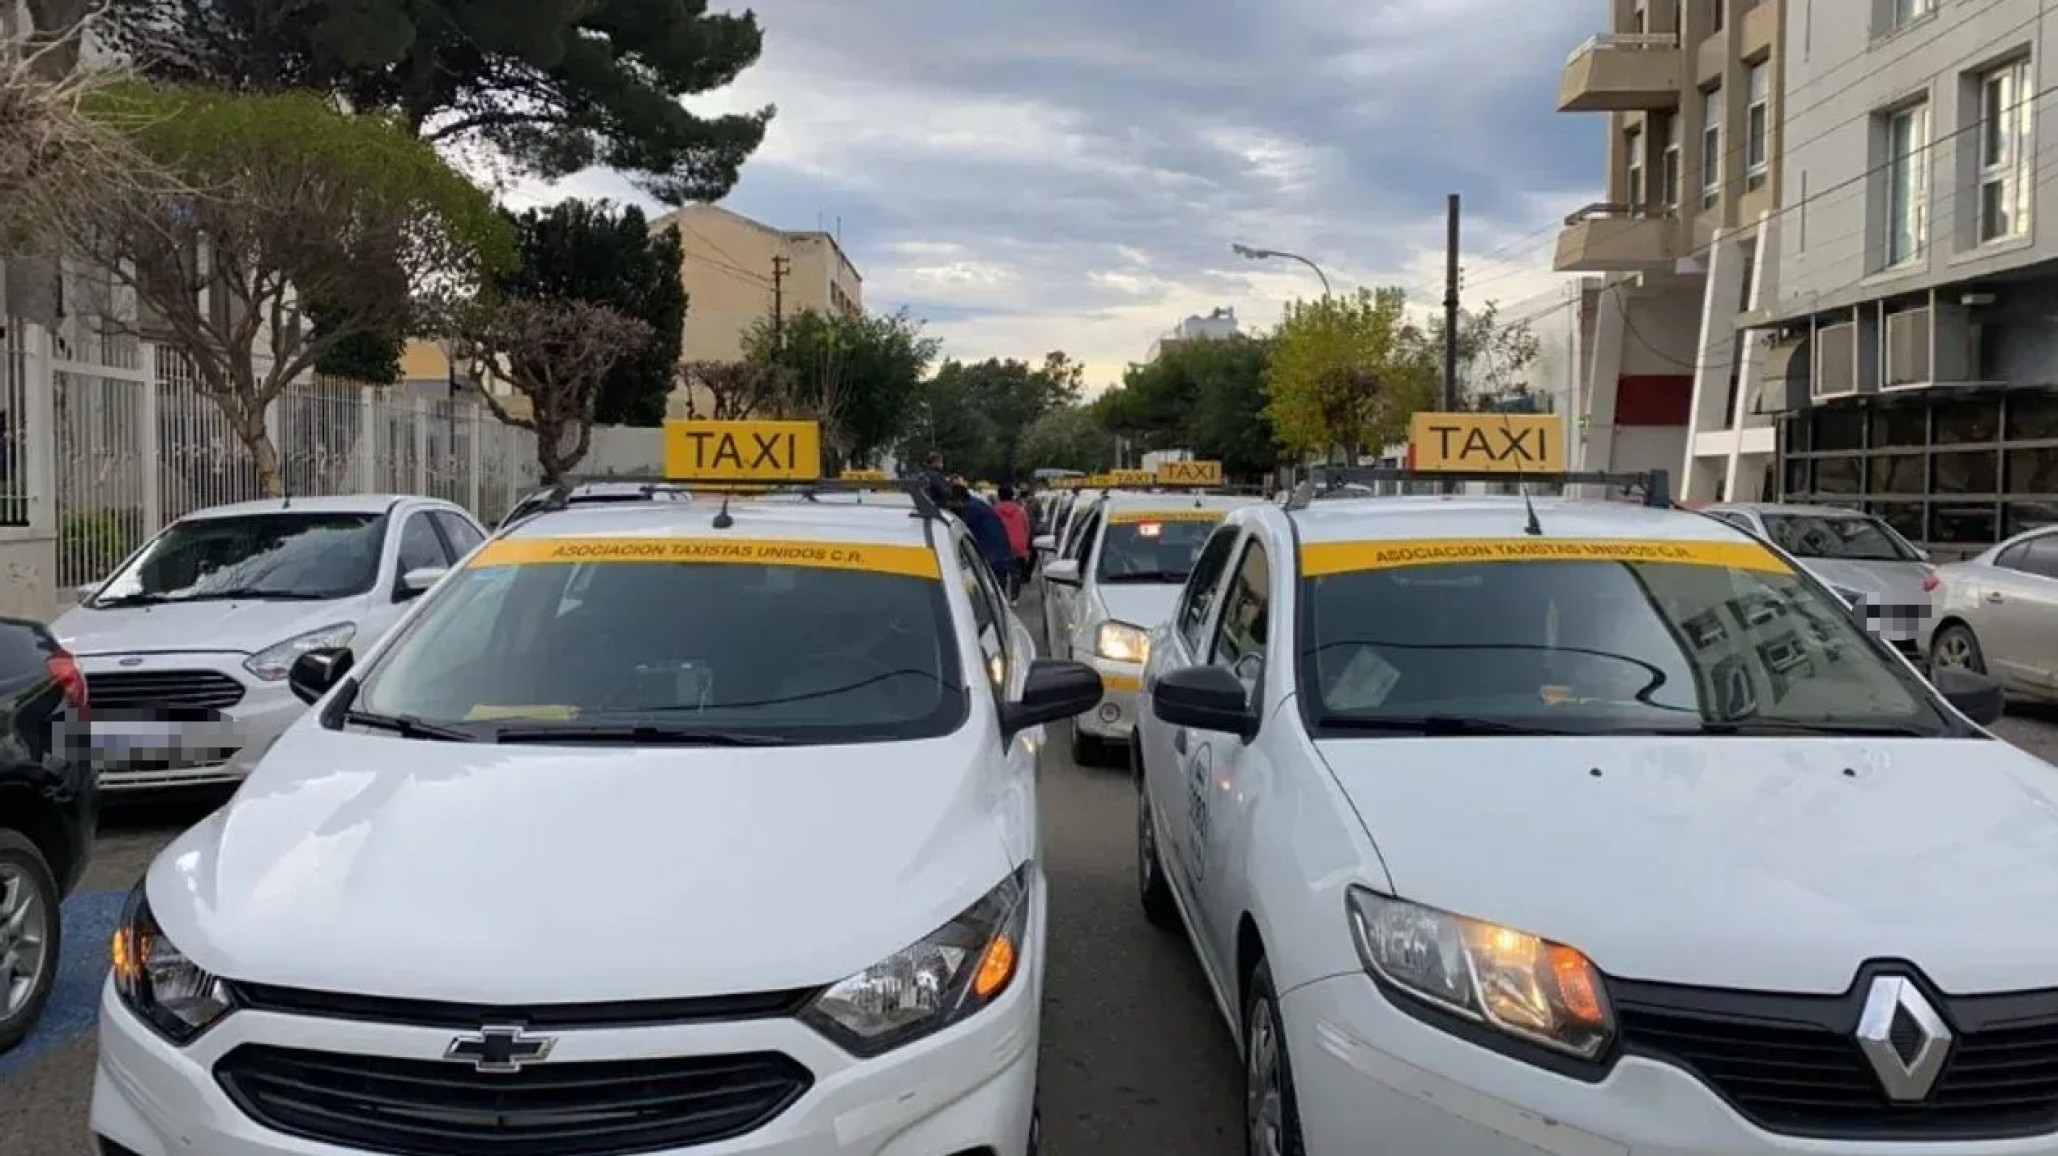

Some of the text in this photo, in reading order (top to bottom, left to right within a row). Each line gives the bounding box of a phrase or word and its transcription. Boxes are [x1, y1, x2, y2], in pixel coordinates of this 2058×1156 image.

[686, 432, 795, 469] TAXI
[1429, 426, 1547, 461] TAXI
[1116, 471, 1149, 482] TAXI
[1164, 463, 1215, 480] TAXI
[553, 544, 666, 557] ASOCIACION
[671, 545, 753, 557] TAXISTAS
[757, 546, 826, 560] UNIDOS
[1376, 544, 1492, 562] ASOCIACION
[1497, 543, 1581, 555] TAXISTAS
[1584, 544, 1656, 557] UNIDOS
